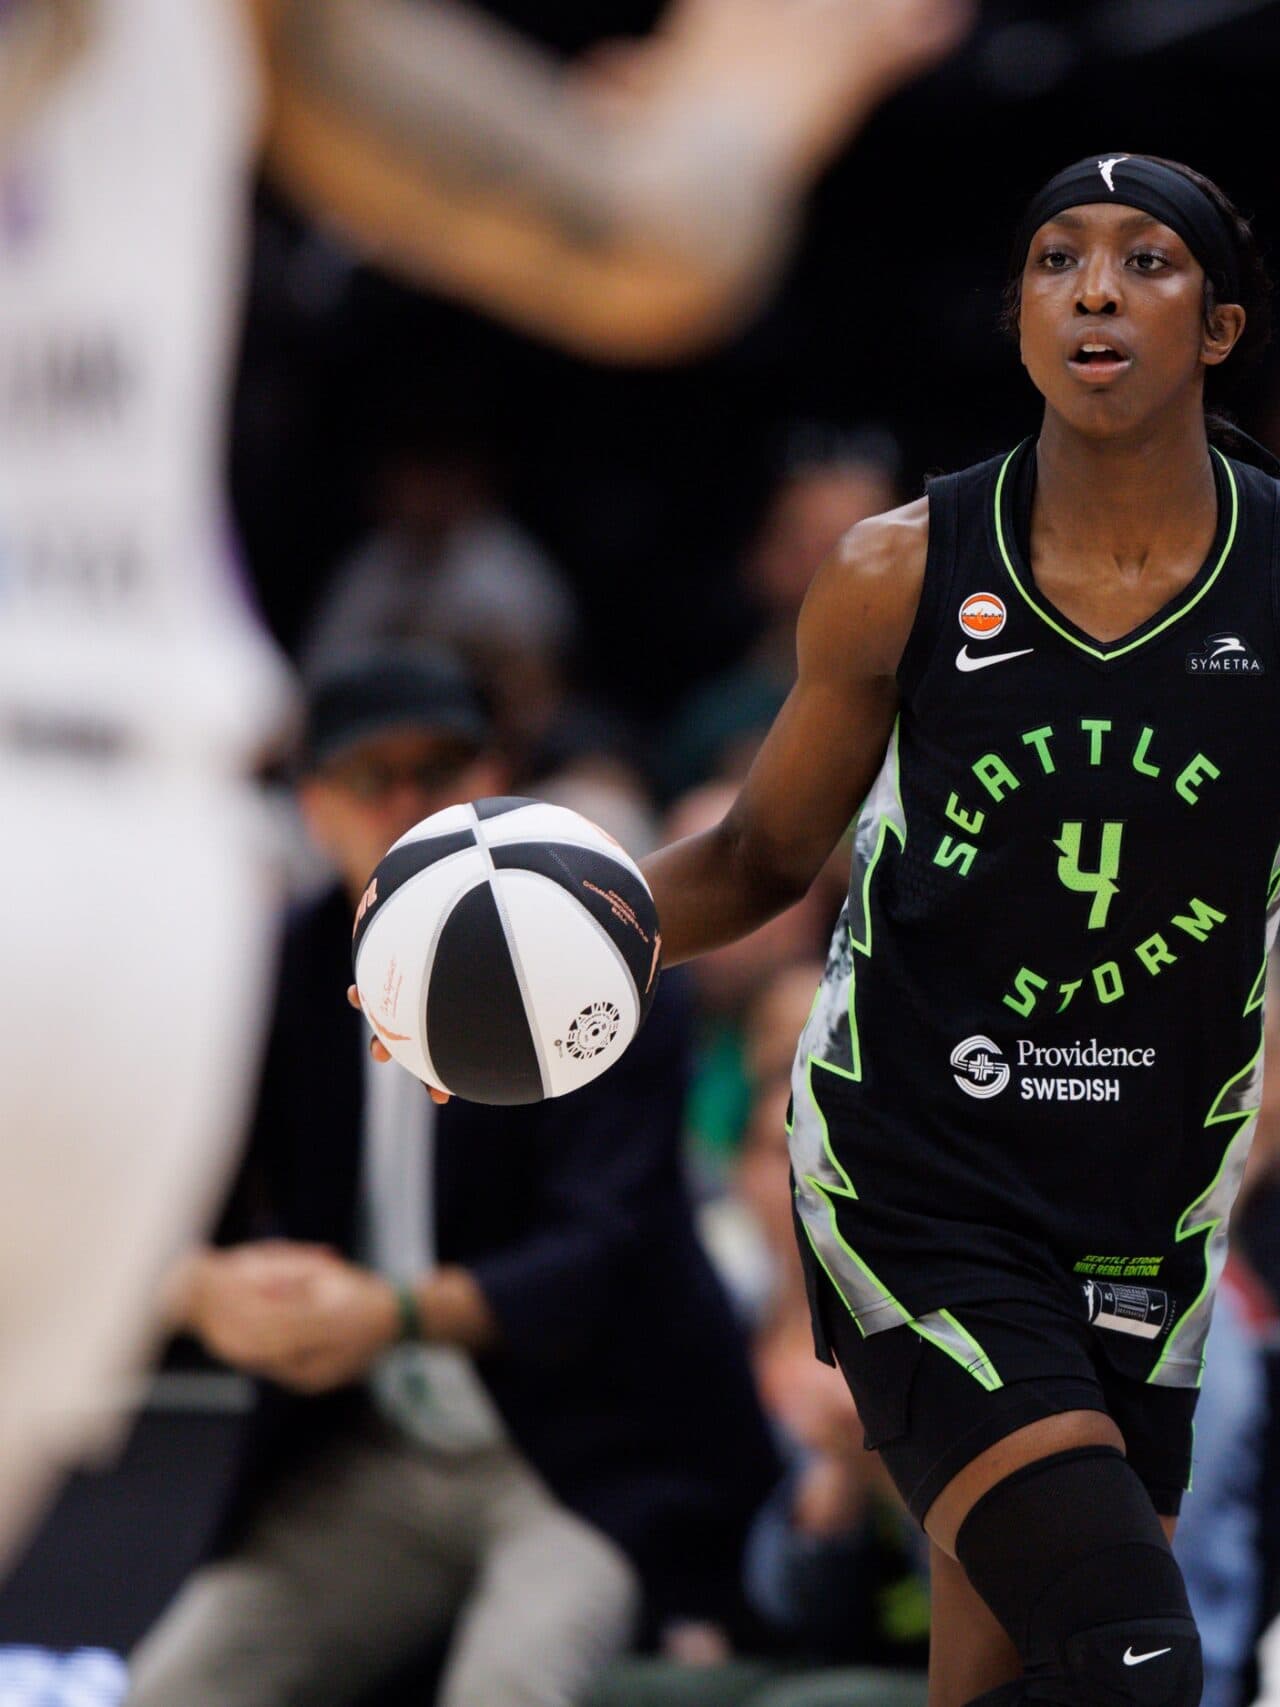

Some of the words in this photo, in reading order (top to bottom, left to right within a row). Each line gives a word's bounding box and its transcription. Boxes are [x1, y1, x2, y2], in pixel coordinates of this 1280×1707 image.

[1191, 658, 1260, 671] SYMETRA
[933, 719, 1221, 878] SEATTLE
[1052, 822, 1123, 930] 4
[1003, 897, 1227, 1018] STORM
[1016, 1038, 1156, 1067] Providence
[1021, 1077, 1120, 1101] SWEDISH
[1123, 1265, 1160, 1277] EDITION
